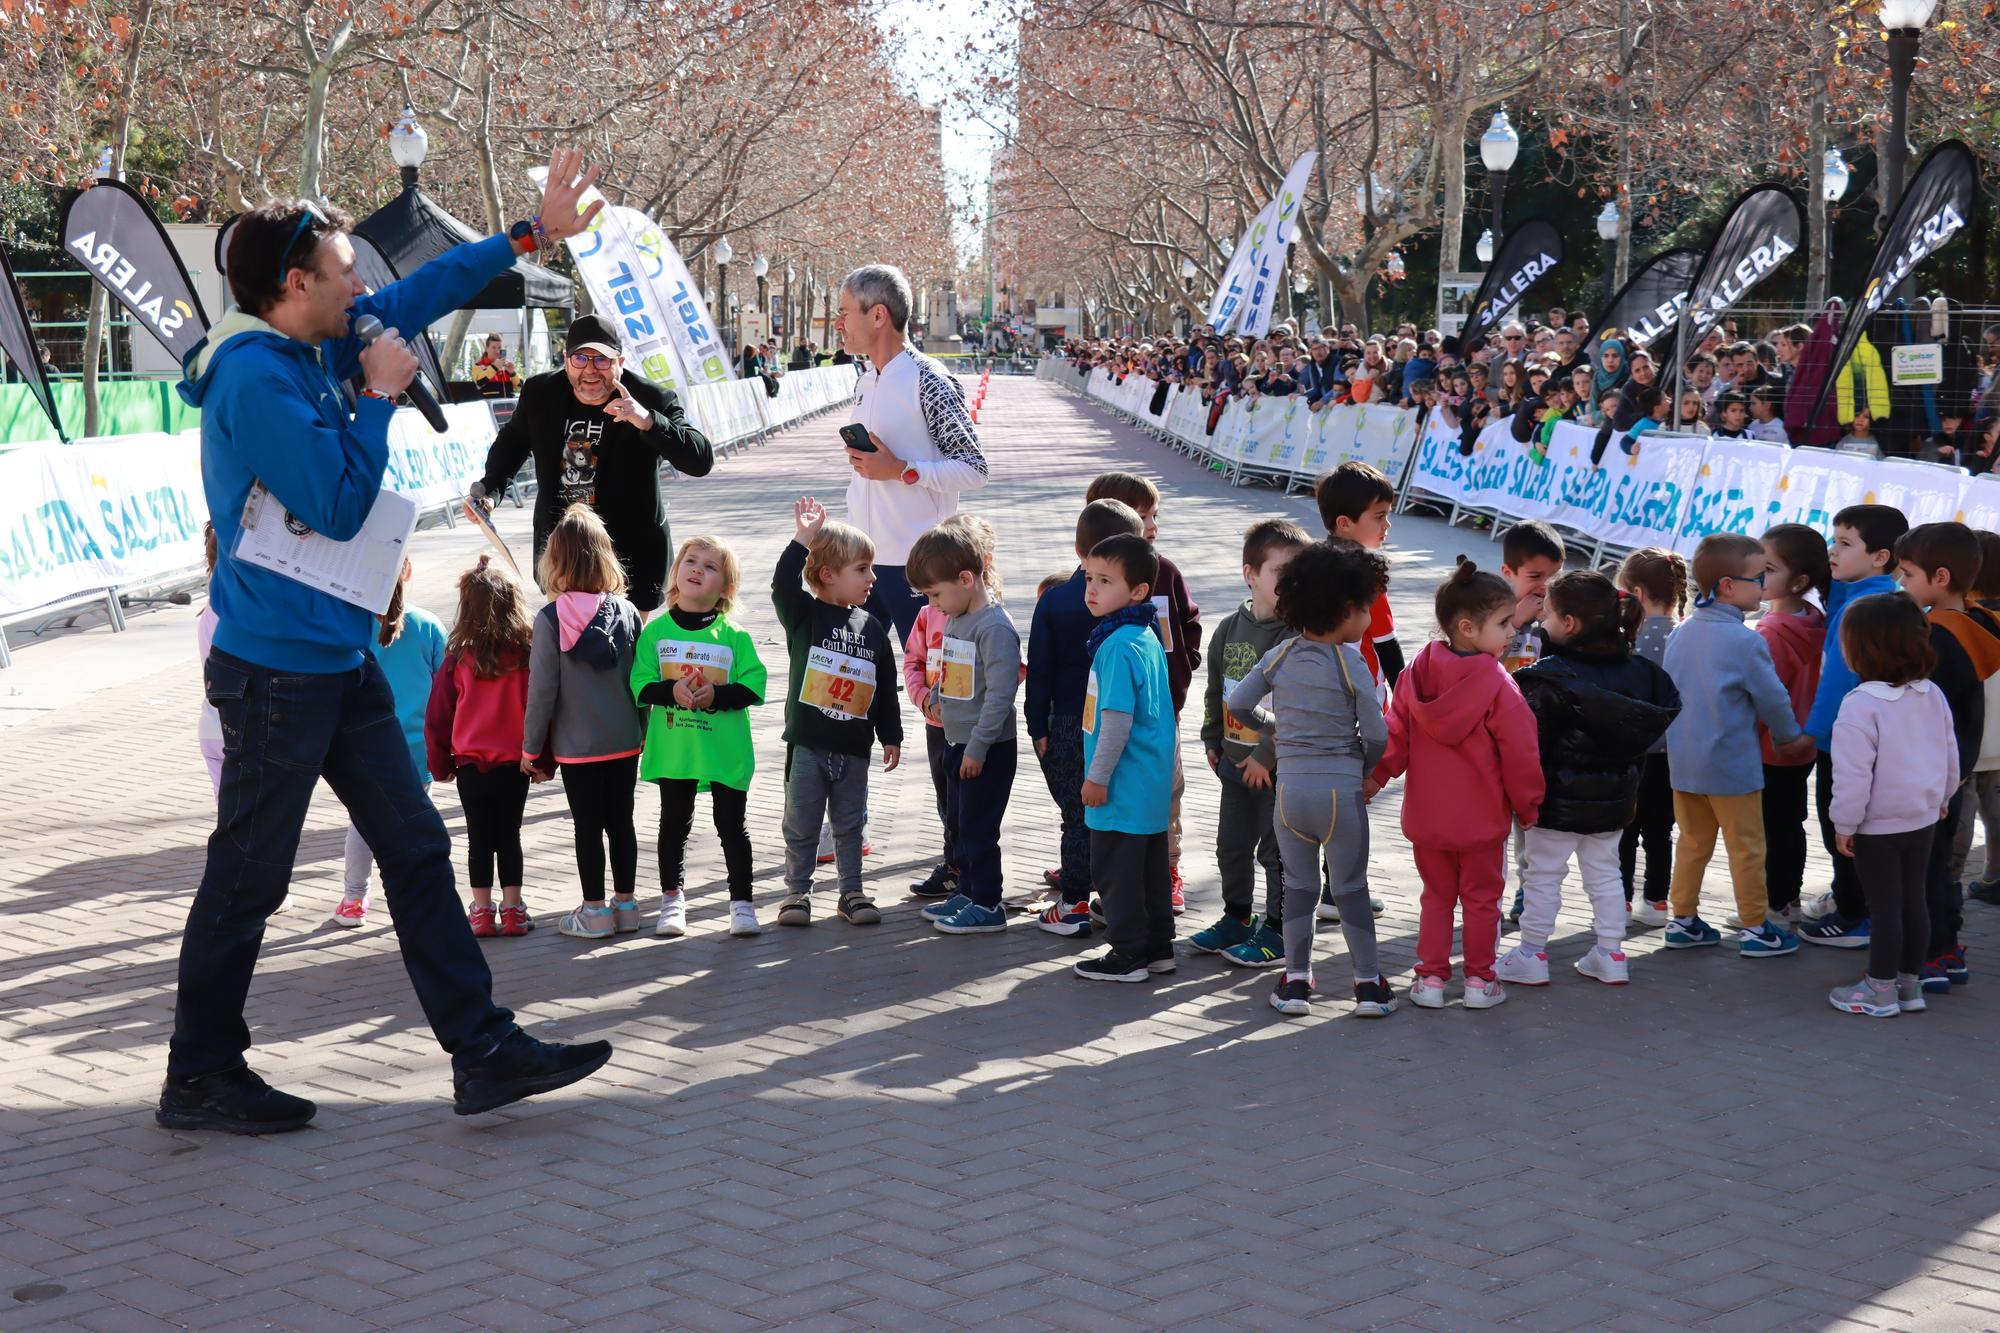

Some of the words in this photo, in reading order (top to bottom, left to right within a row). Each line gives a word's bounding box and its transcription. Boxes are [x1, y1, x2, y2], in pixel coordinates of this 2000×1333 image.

[1480, 252, 1557, 327] SALERA
[1693, 234, 1796, 334] SALERA
[99, 486, 198, 560] SALERA
[822, 638, 847, 653] CHILD
[832, 627, 865, 646] SWEET
[685, 652, 710, 661] marató
[828, 677, 855, 702] 42
